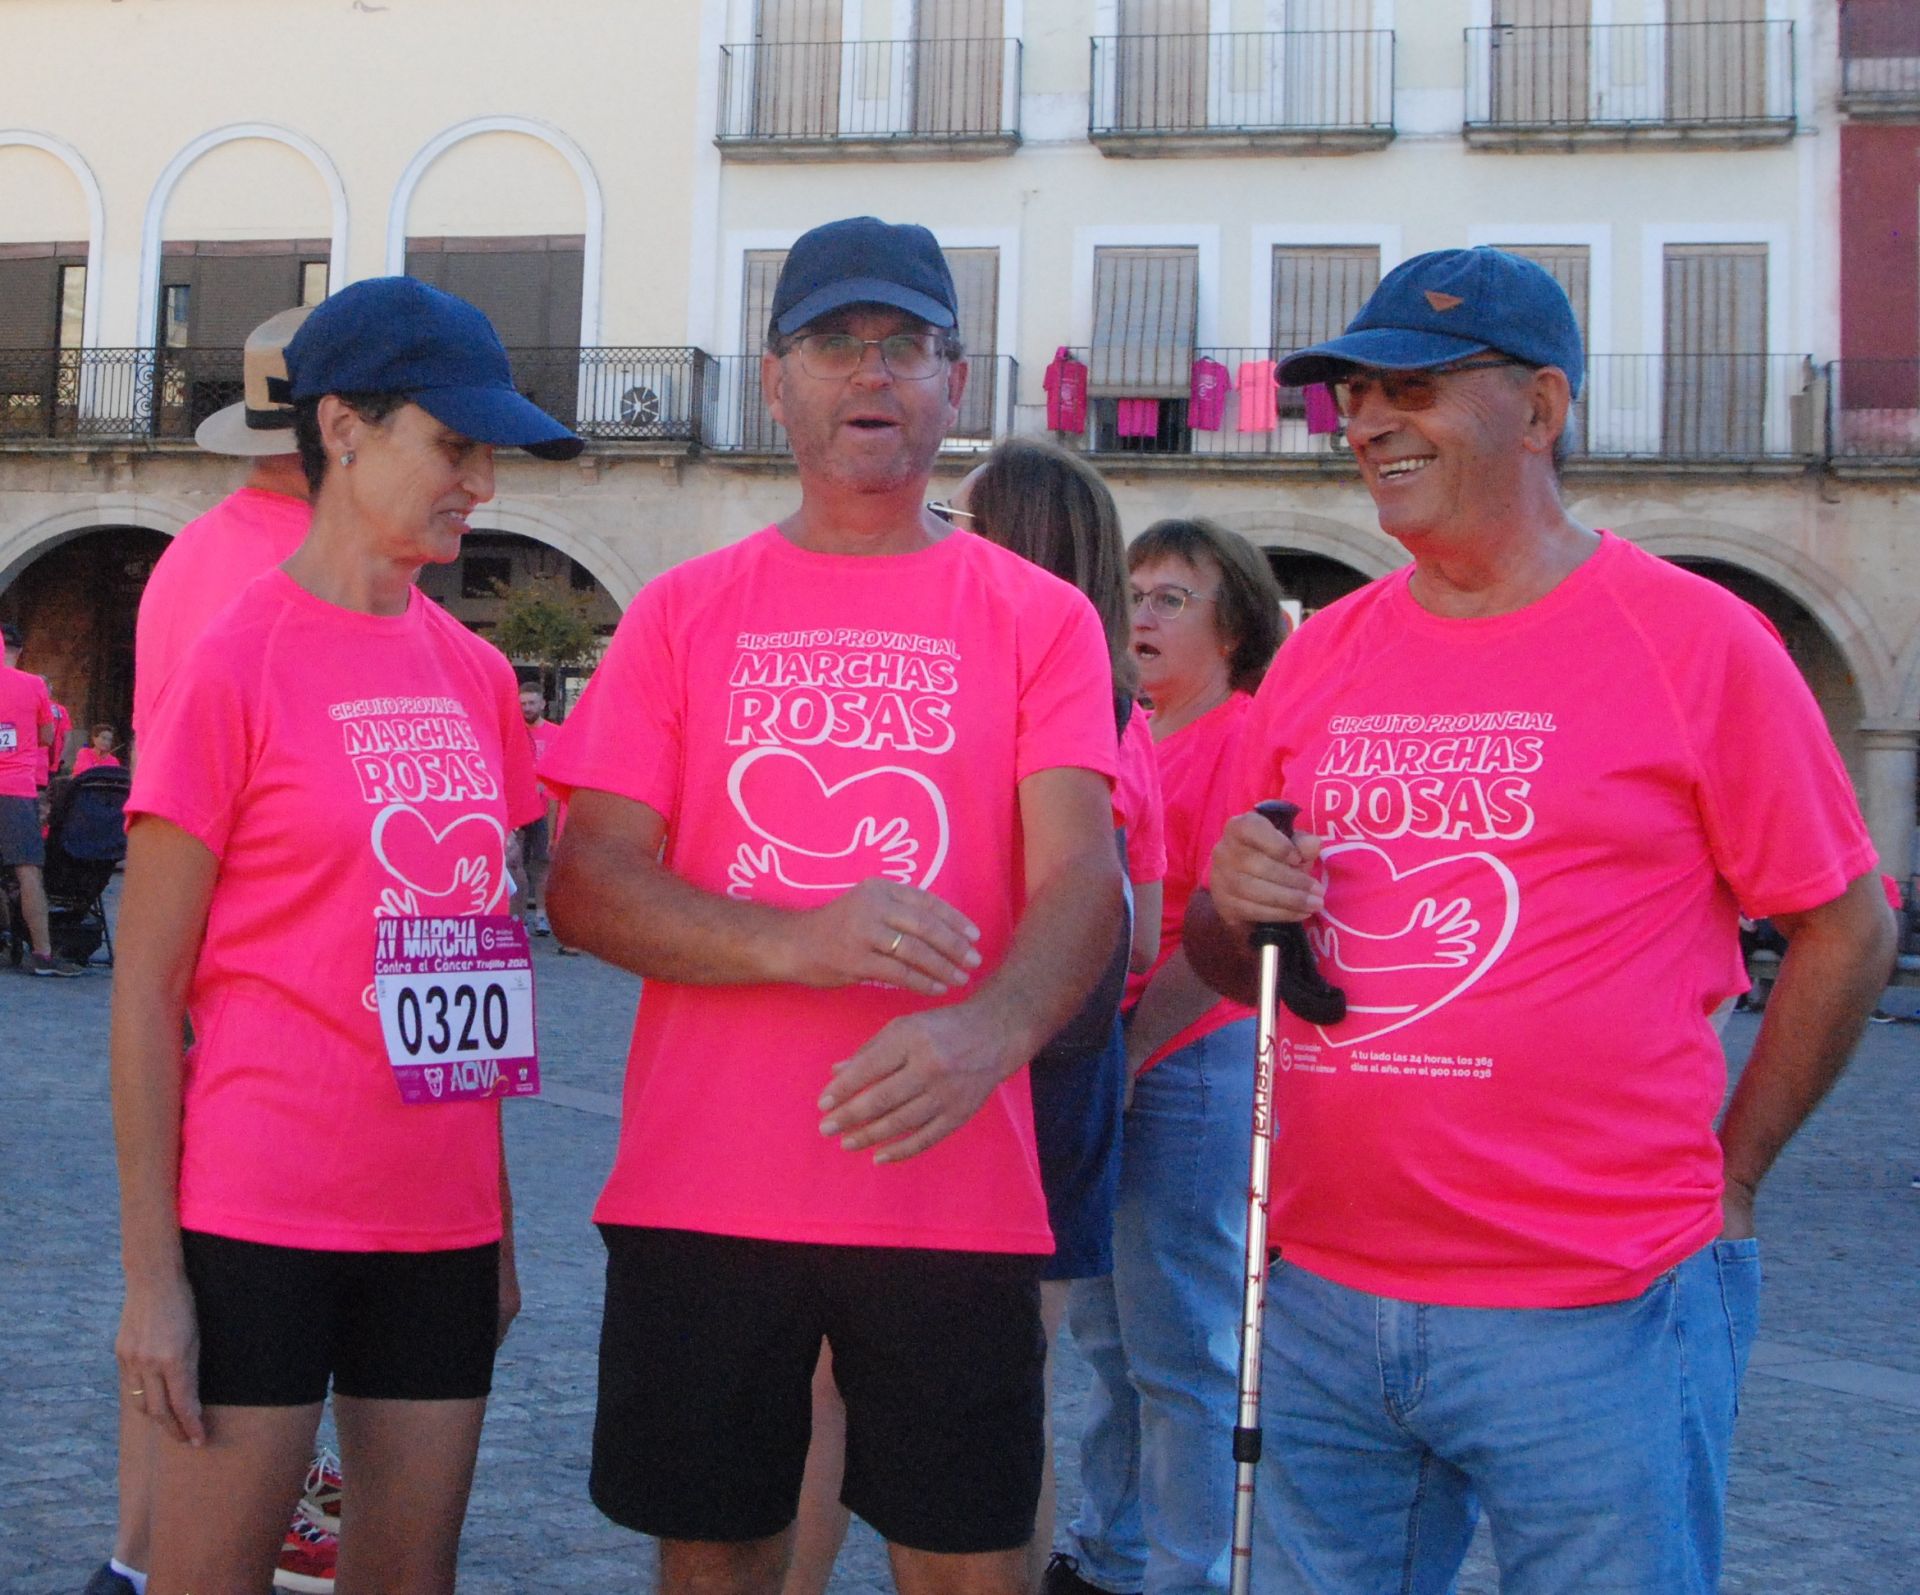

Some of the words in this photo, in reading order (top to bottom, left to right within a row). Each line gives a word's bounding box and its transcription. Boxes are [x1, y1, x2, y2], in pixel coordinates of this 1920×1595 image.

[736, 630, 833, 650] CIRCUITO
[834, 628, 961, 661] PROVINCIAL
[729, 651, 959, 695] MARCHAS
[329, 698, 398, 721] CIRCUITO
[725, 686, 956, 755] ROSAS
[1328, 713, 1425, 734] CIRCUITO
[1424, 712, 1557, 732] PROVINCIAL
[343, 717, 480, 754] MARCHAS
[1315, 736, 1545, 776] MARCHAS
[352, 751, 498, 803] ROSAS
[1312, 775, 1535, 841] ROSAS
[376, 919, 398, 960] XV
[402, 918, 478, 959] MARCHA
[375, 959, 412, 974] Contra
[418, 960, 429, 972] el
[434, 958, 474, 972] Cáncer
[397, 983, 509, 1056] 0320
[1351, 1050, 1358, 1060] A
[1359, 1050, 1369, 1060] tu
[1370, 1050, 1392, 1061] lado
[1393, 1052, 1408, 1062] las
[1409, 1055, 1422, 1064] 24
[1424, 1054, 1456, 1066] horas,
[1457, 1055, 1473, 1065] los
[1475, 1057, 1494, 1068] 365
[1403, 1066, 1417, 1075] en
[1418, 1066, 1429, 1076] el
[1430, 1068, 1450, 1077] 900
[1452, 1068, 1471, 1077] 100
[1252, 1035, 1277, 1141] Serval
